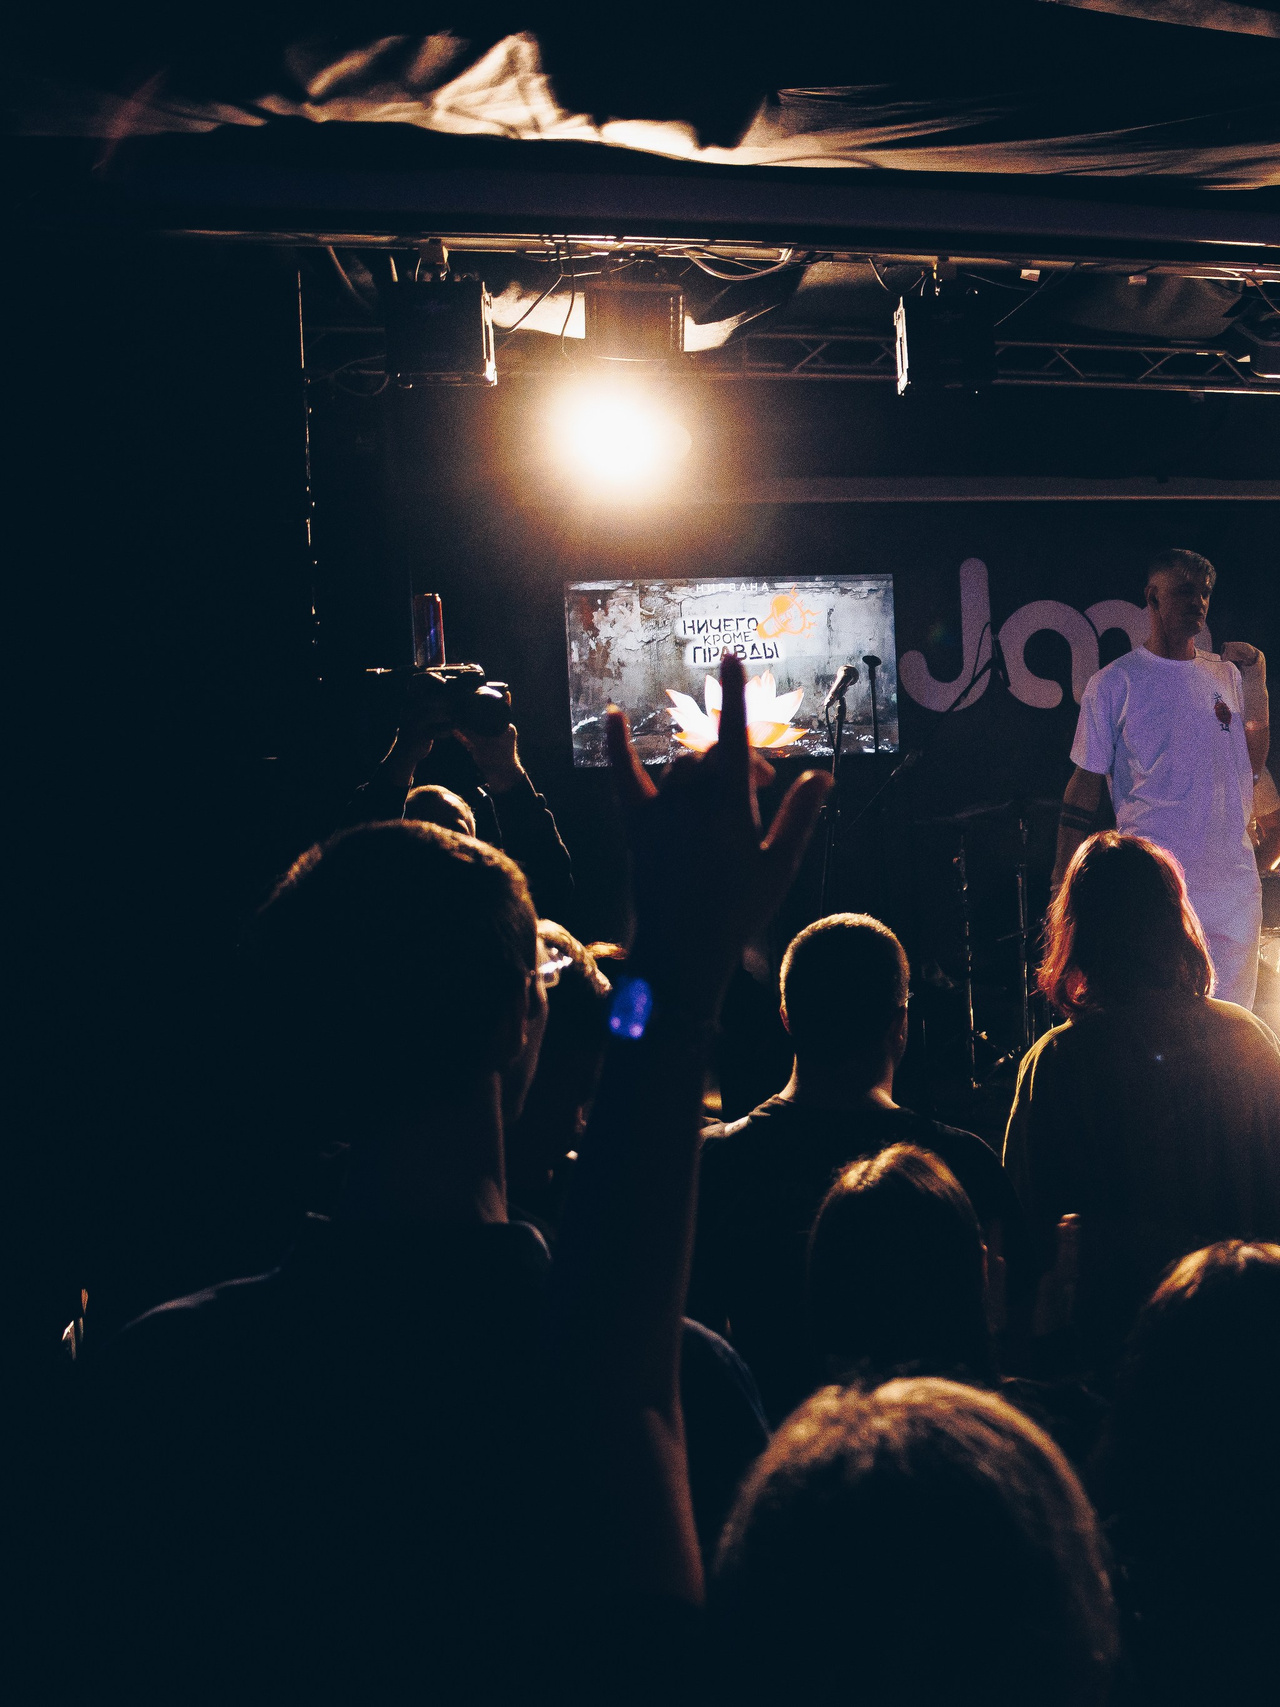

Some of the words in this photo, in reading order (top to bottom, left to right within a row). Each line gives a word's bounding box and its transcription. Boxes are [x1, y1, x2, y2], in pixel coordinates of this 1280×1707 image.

[696, 582, 769, 593] НИРВАНА
[683, 617, 759, 635] НИЧЕГО
[703, 631, 753, 646] КРОМЕ
